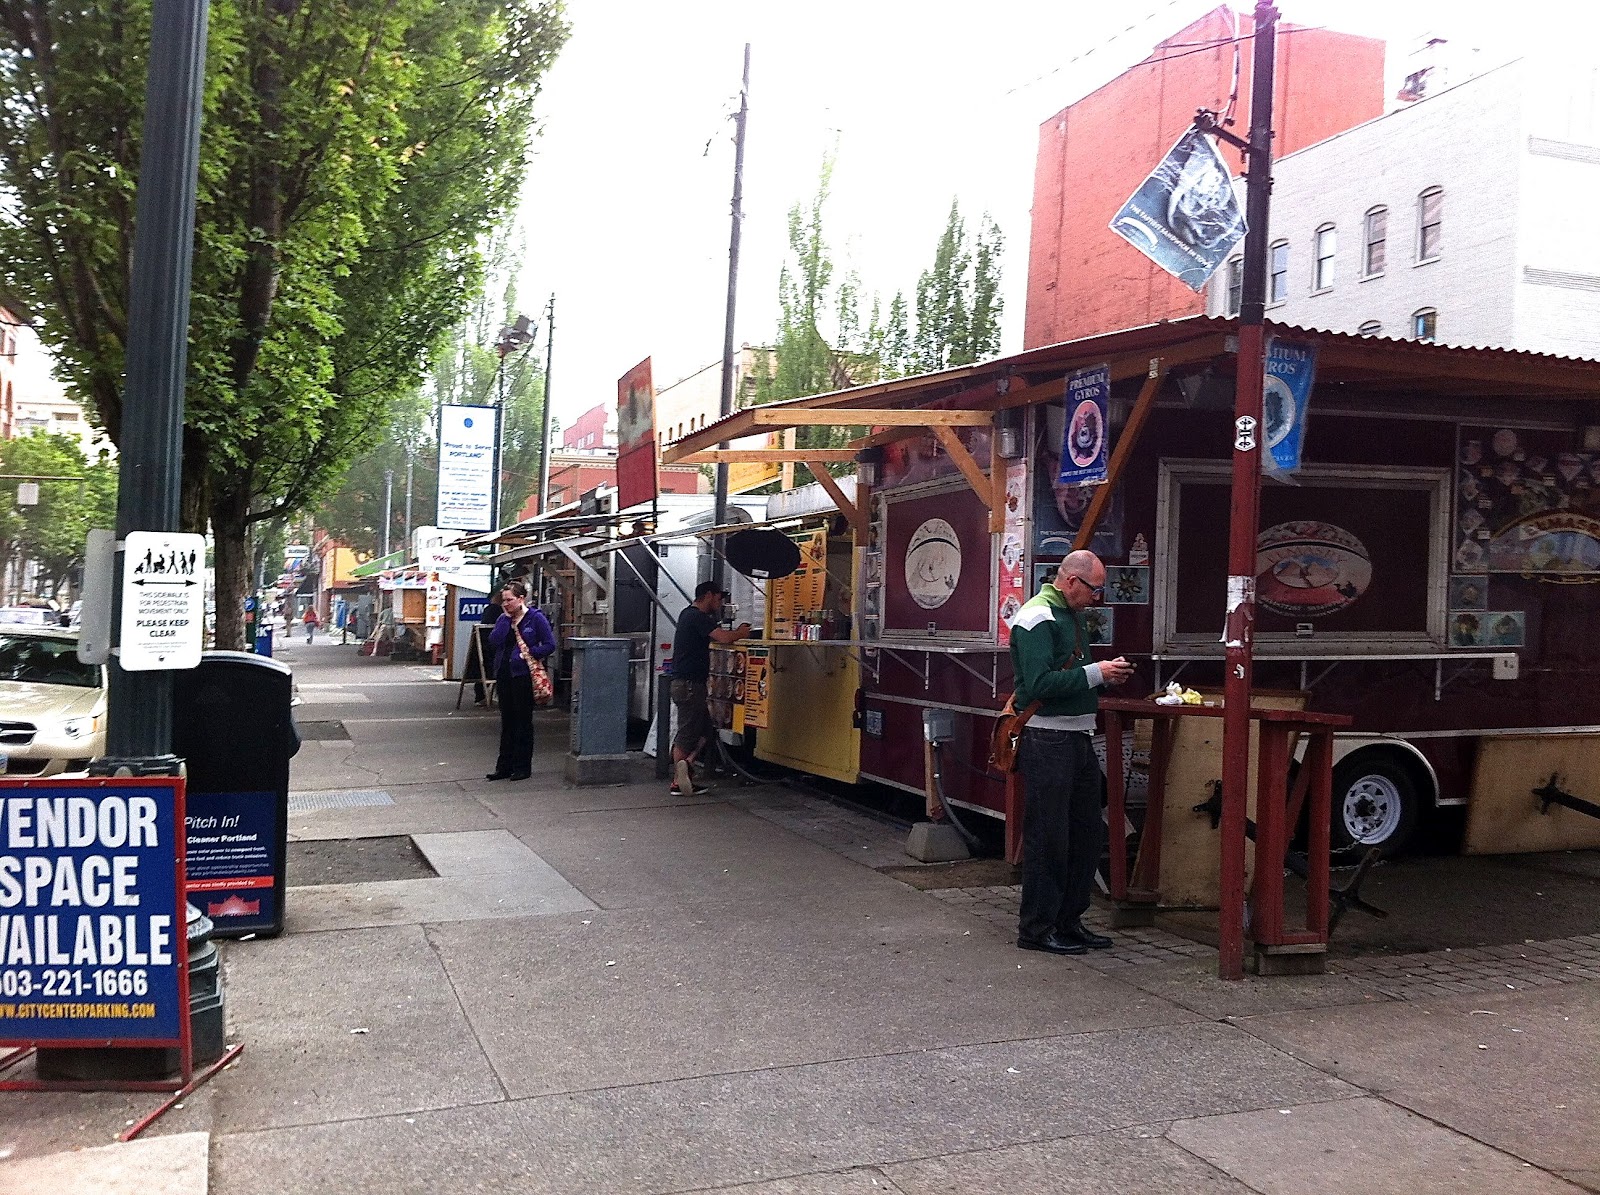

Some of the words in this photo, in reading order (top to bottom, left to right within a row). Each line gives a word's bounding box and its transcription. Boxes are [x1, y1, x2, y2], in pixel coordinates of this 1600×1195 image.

[1267, 361, 1296, 374] ROS
[1070, 372, 1104, 391] PREMIUM
[1075, 387, 1100, 401] GYROS
[136, 619, 167, 627] PLEASE
[169, 619, 190, 627] KEEP
[0, 797, 158, 848] ENDOR
[184, 815, 218, 829] Pitch
[221, 815, 240, 828] In!
[186, 836, 220, 844] Cleaner
[220, 833, 258, 843] Portland
[0, 856, 140, 907] SPACE
[0, 969, 148, 997] 03-221-1666
